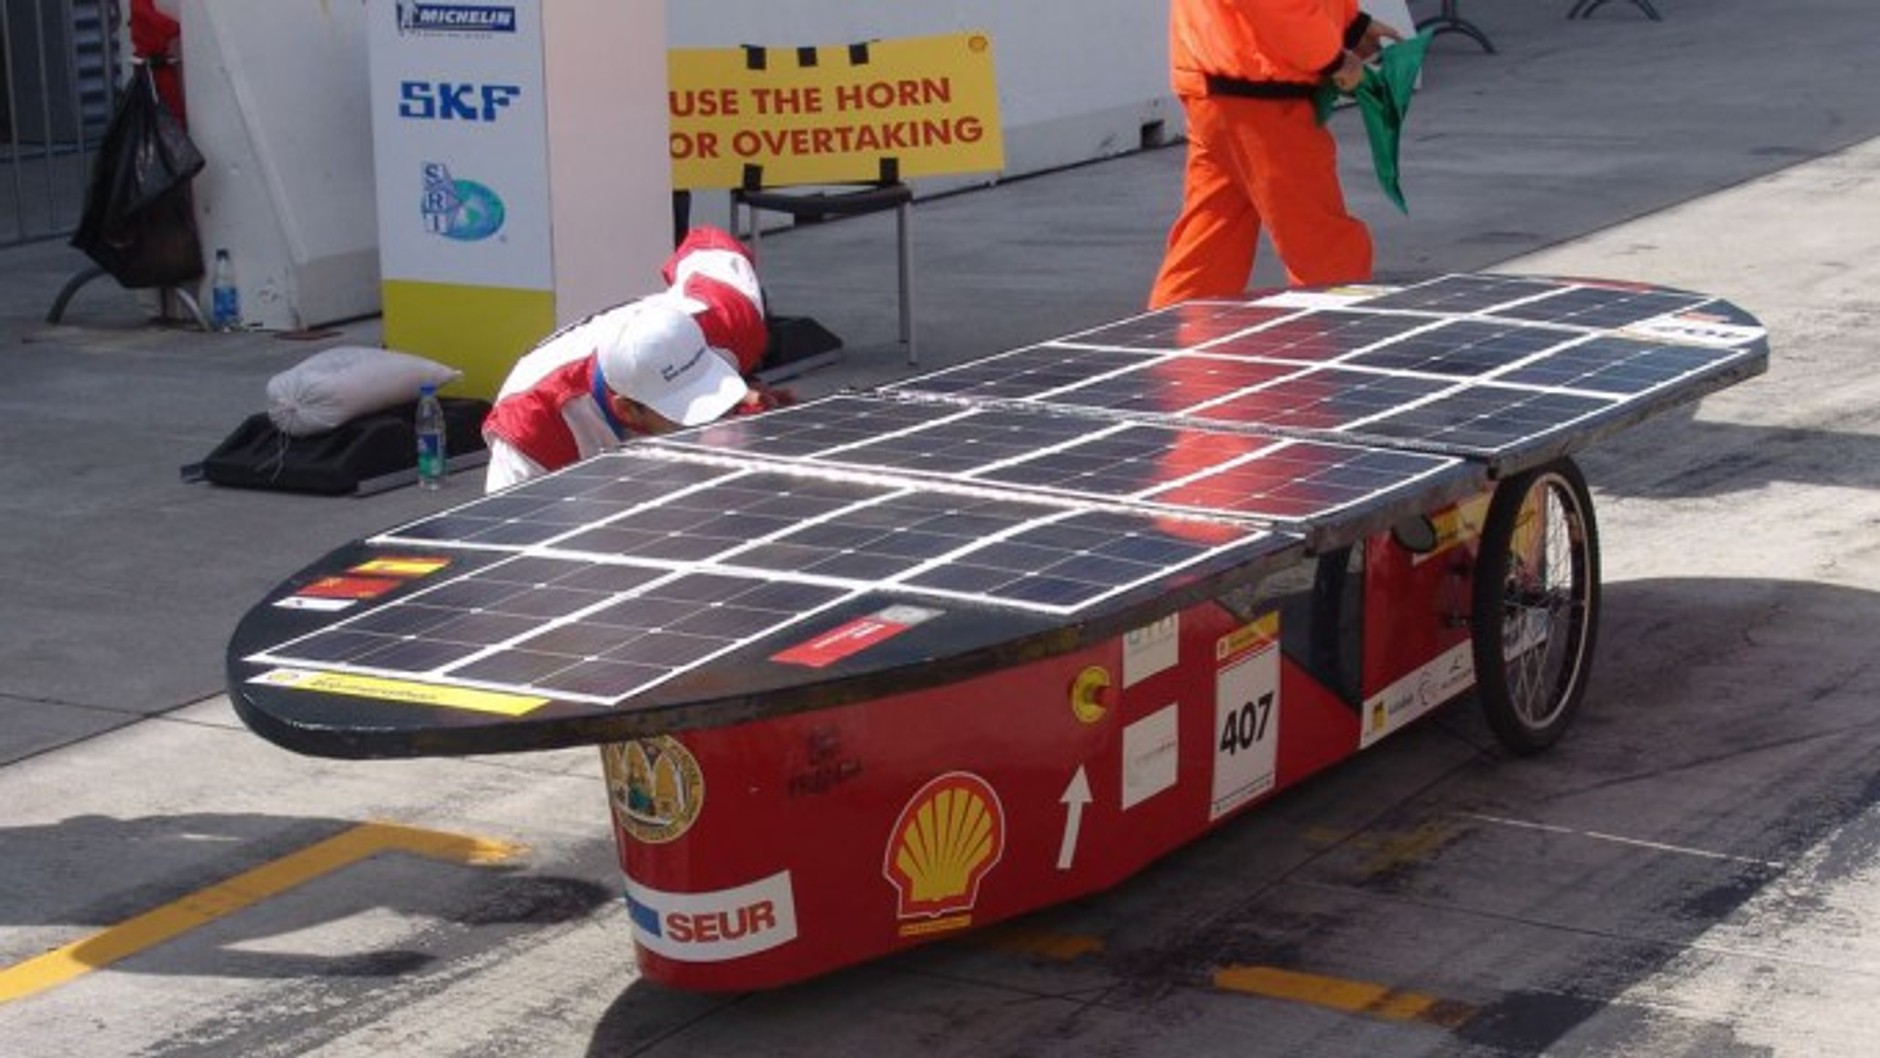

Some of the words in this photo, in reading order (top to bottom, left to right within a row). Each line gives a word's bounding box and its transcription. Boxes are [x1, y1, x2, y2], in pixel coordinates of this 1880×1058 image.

[420, 8, 513, 25] MICHELIN
[399, 81, 520, 122] SKF
[669, 88, 739, 117] USE
[752, 87, 822, 115] THE
[836, 77, 951, 112] HORN
[732, 116, 983, 157] OVERTAKING
[1219, 690, 1274, 756] 407
[666, 902, 776, 943] SEUR
